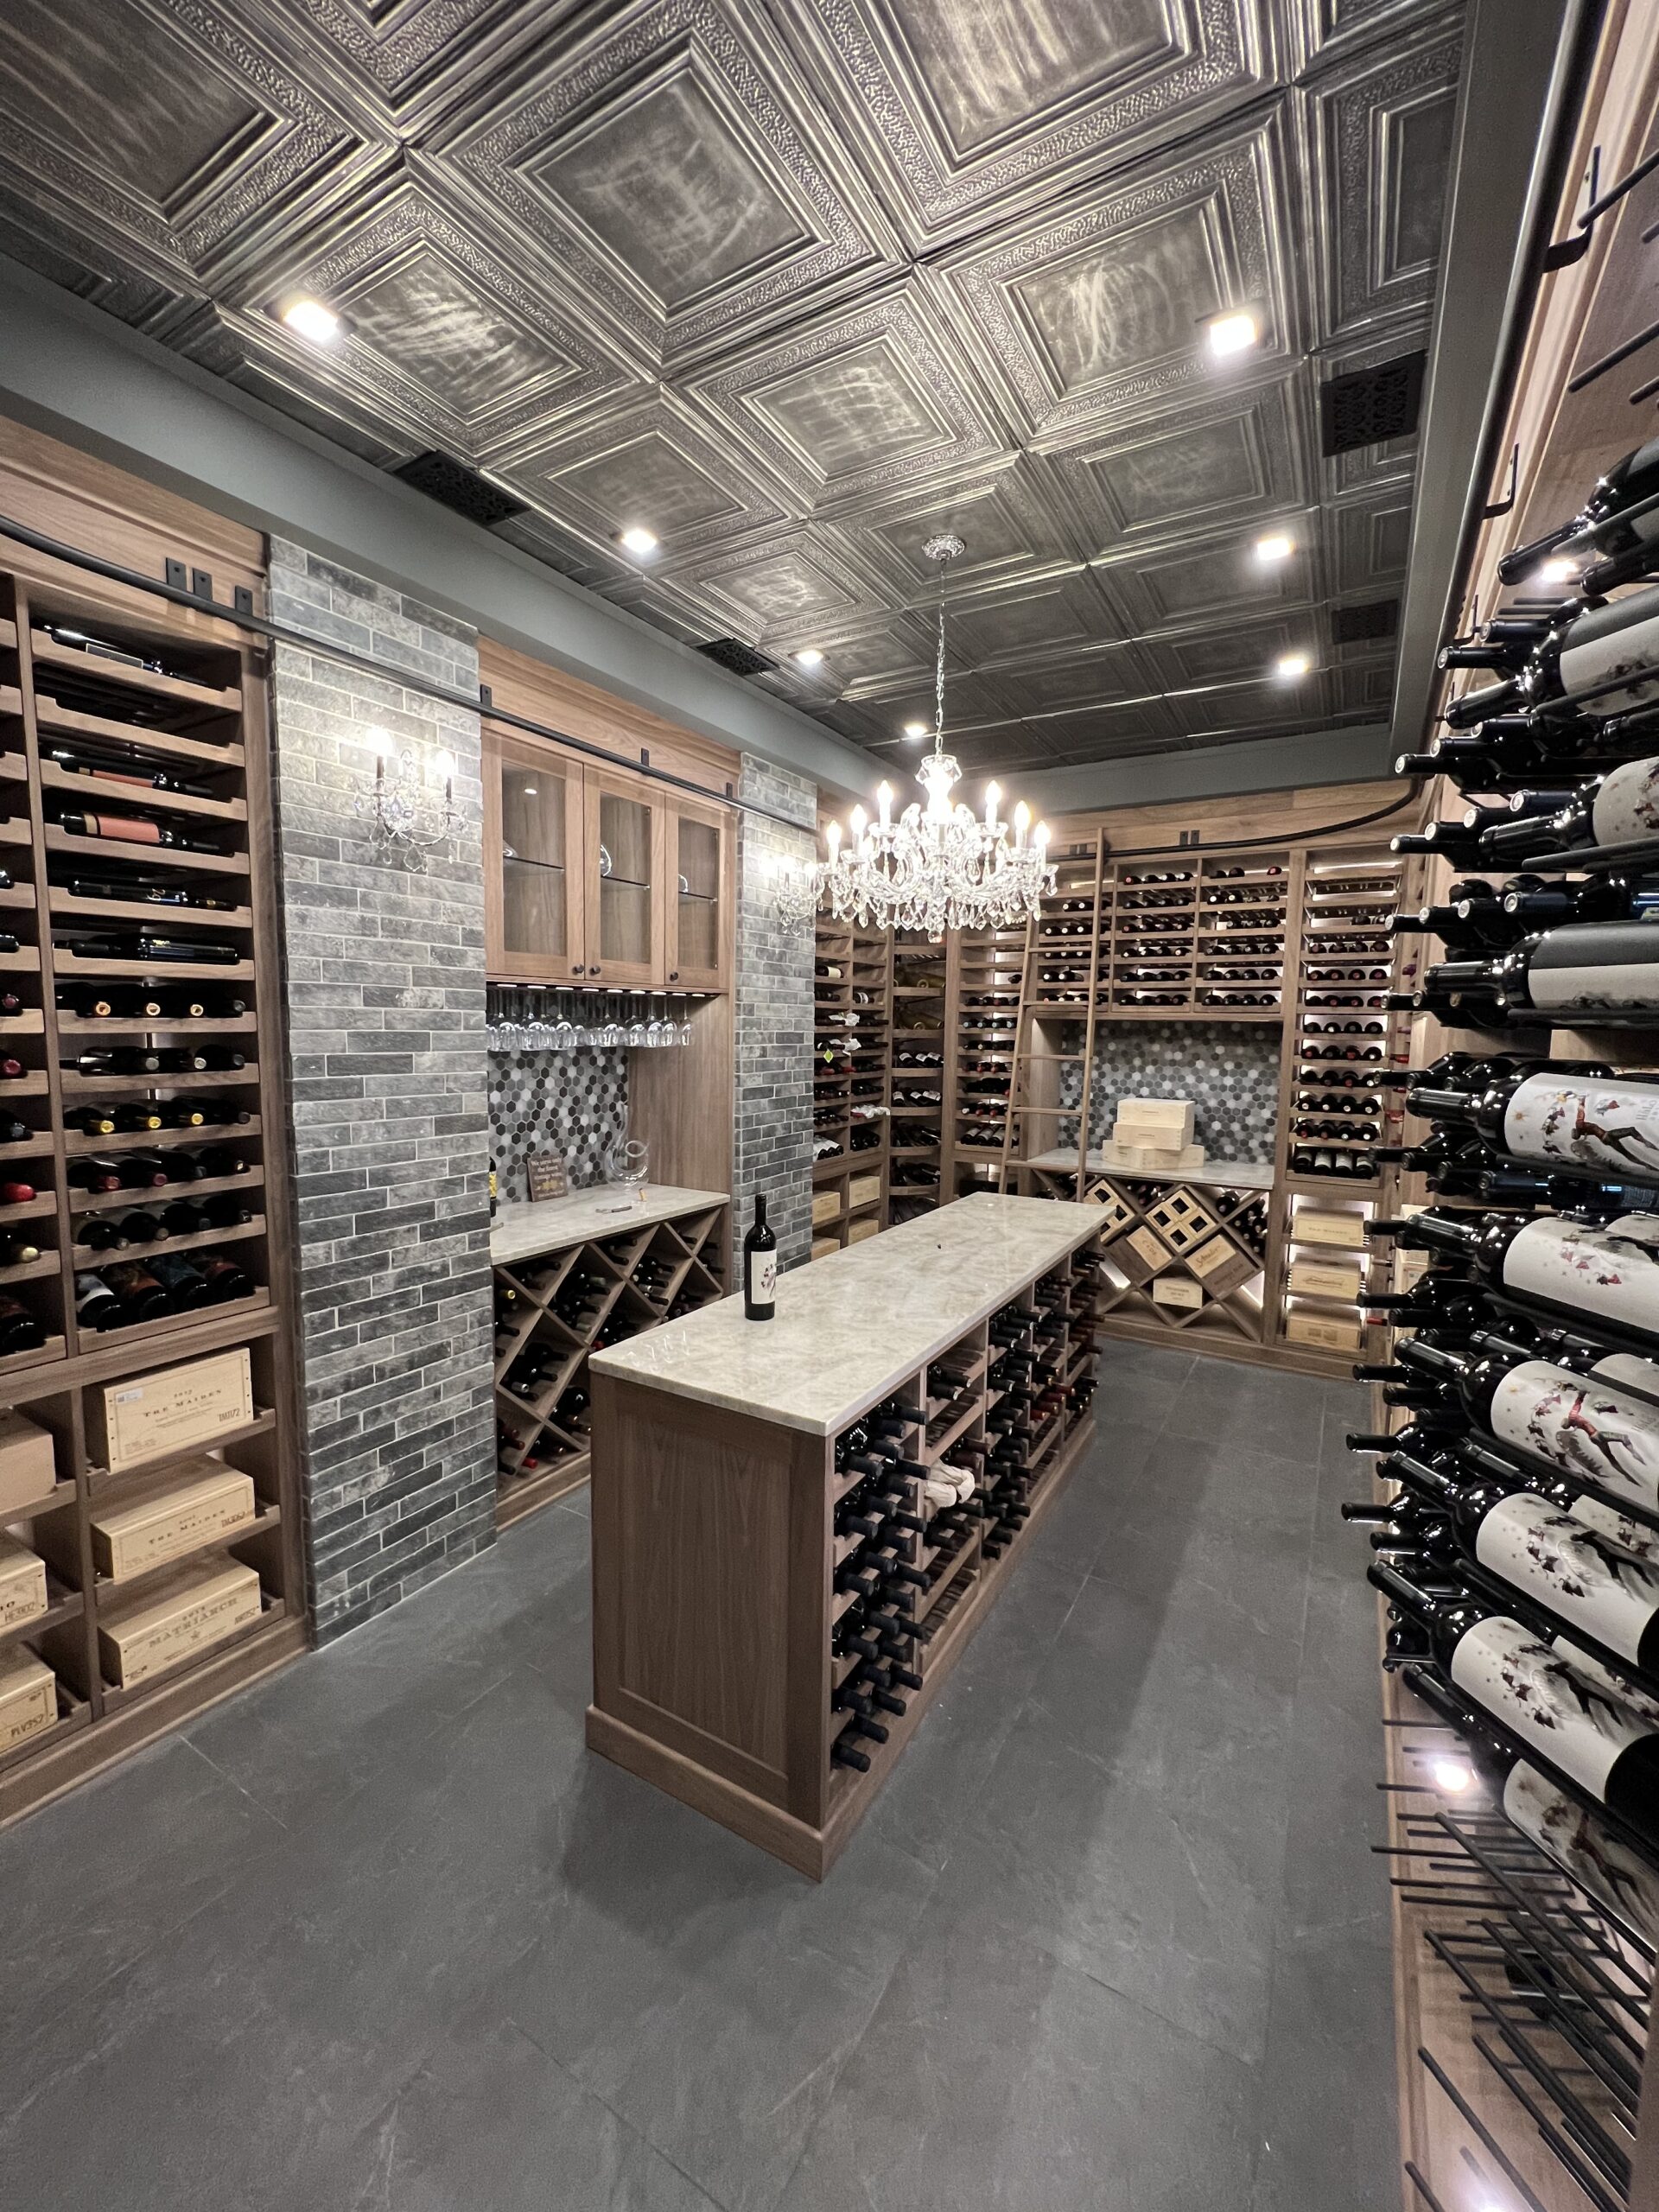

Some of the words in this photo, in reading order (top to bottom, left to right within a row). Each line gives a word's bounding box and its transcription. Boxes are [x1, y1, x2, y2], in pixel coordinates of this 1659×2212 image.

[143, 1407, 168, 1418] THE
[175, 1389, 222, 1408] MAIDEN
[149, 1533, 173, 1545] THE
[180, 1510, 226, 1531] MAIDEN
[149, 1598, 238, 1648] MATRIARCH
